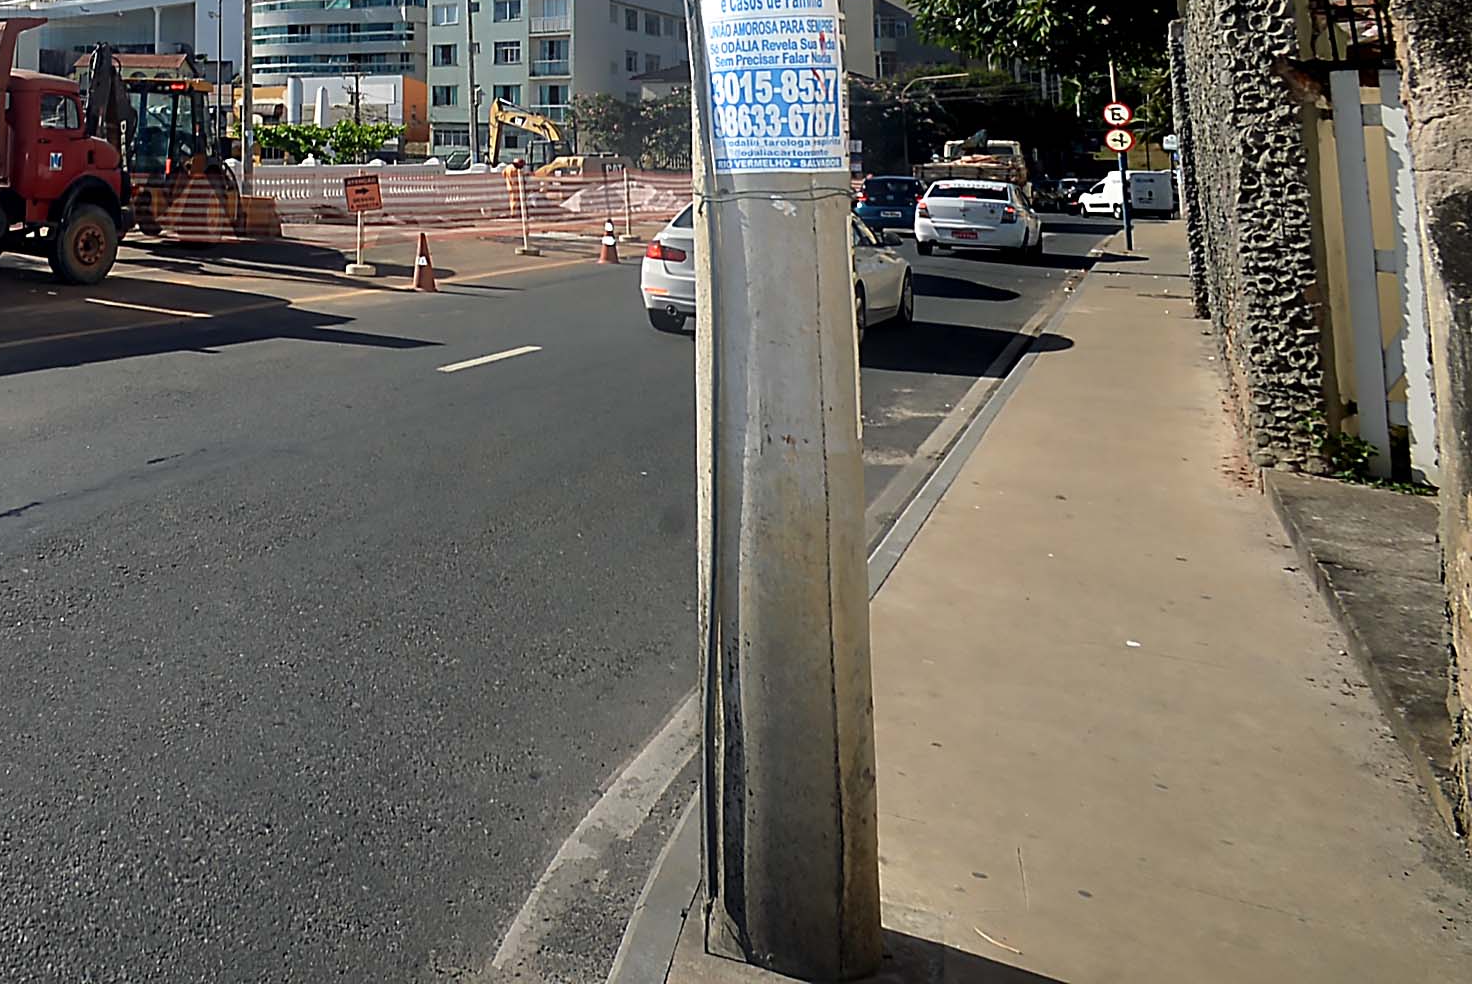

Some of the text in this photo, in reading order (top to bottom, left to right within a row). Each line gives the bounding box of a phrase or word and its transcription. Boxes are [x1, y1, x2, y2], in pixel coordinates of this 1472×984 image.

[733, 19, 780, 37] AMOROSA
[780, 19, 806, 34] PARA
[806, 18, 833, 34] SEMPRE
[721, 38, 759, 54] ODÁLIA
[762, 38, 798, 52] Revela
[800, 37, 817, 50] Sua
[715, 51, 832, 68] Sem Precisar Falar Nada
[712, 69, 837, 105] 3015-8537
[714, 103, 836, 137] 98633-6787
[764, 138, 810, 148] tarologa
[717, 159, 732, 168] RIO
[734, 158, 791, 168] VERMELHO
[800, 158, 841, 168] SALVADOR
